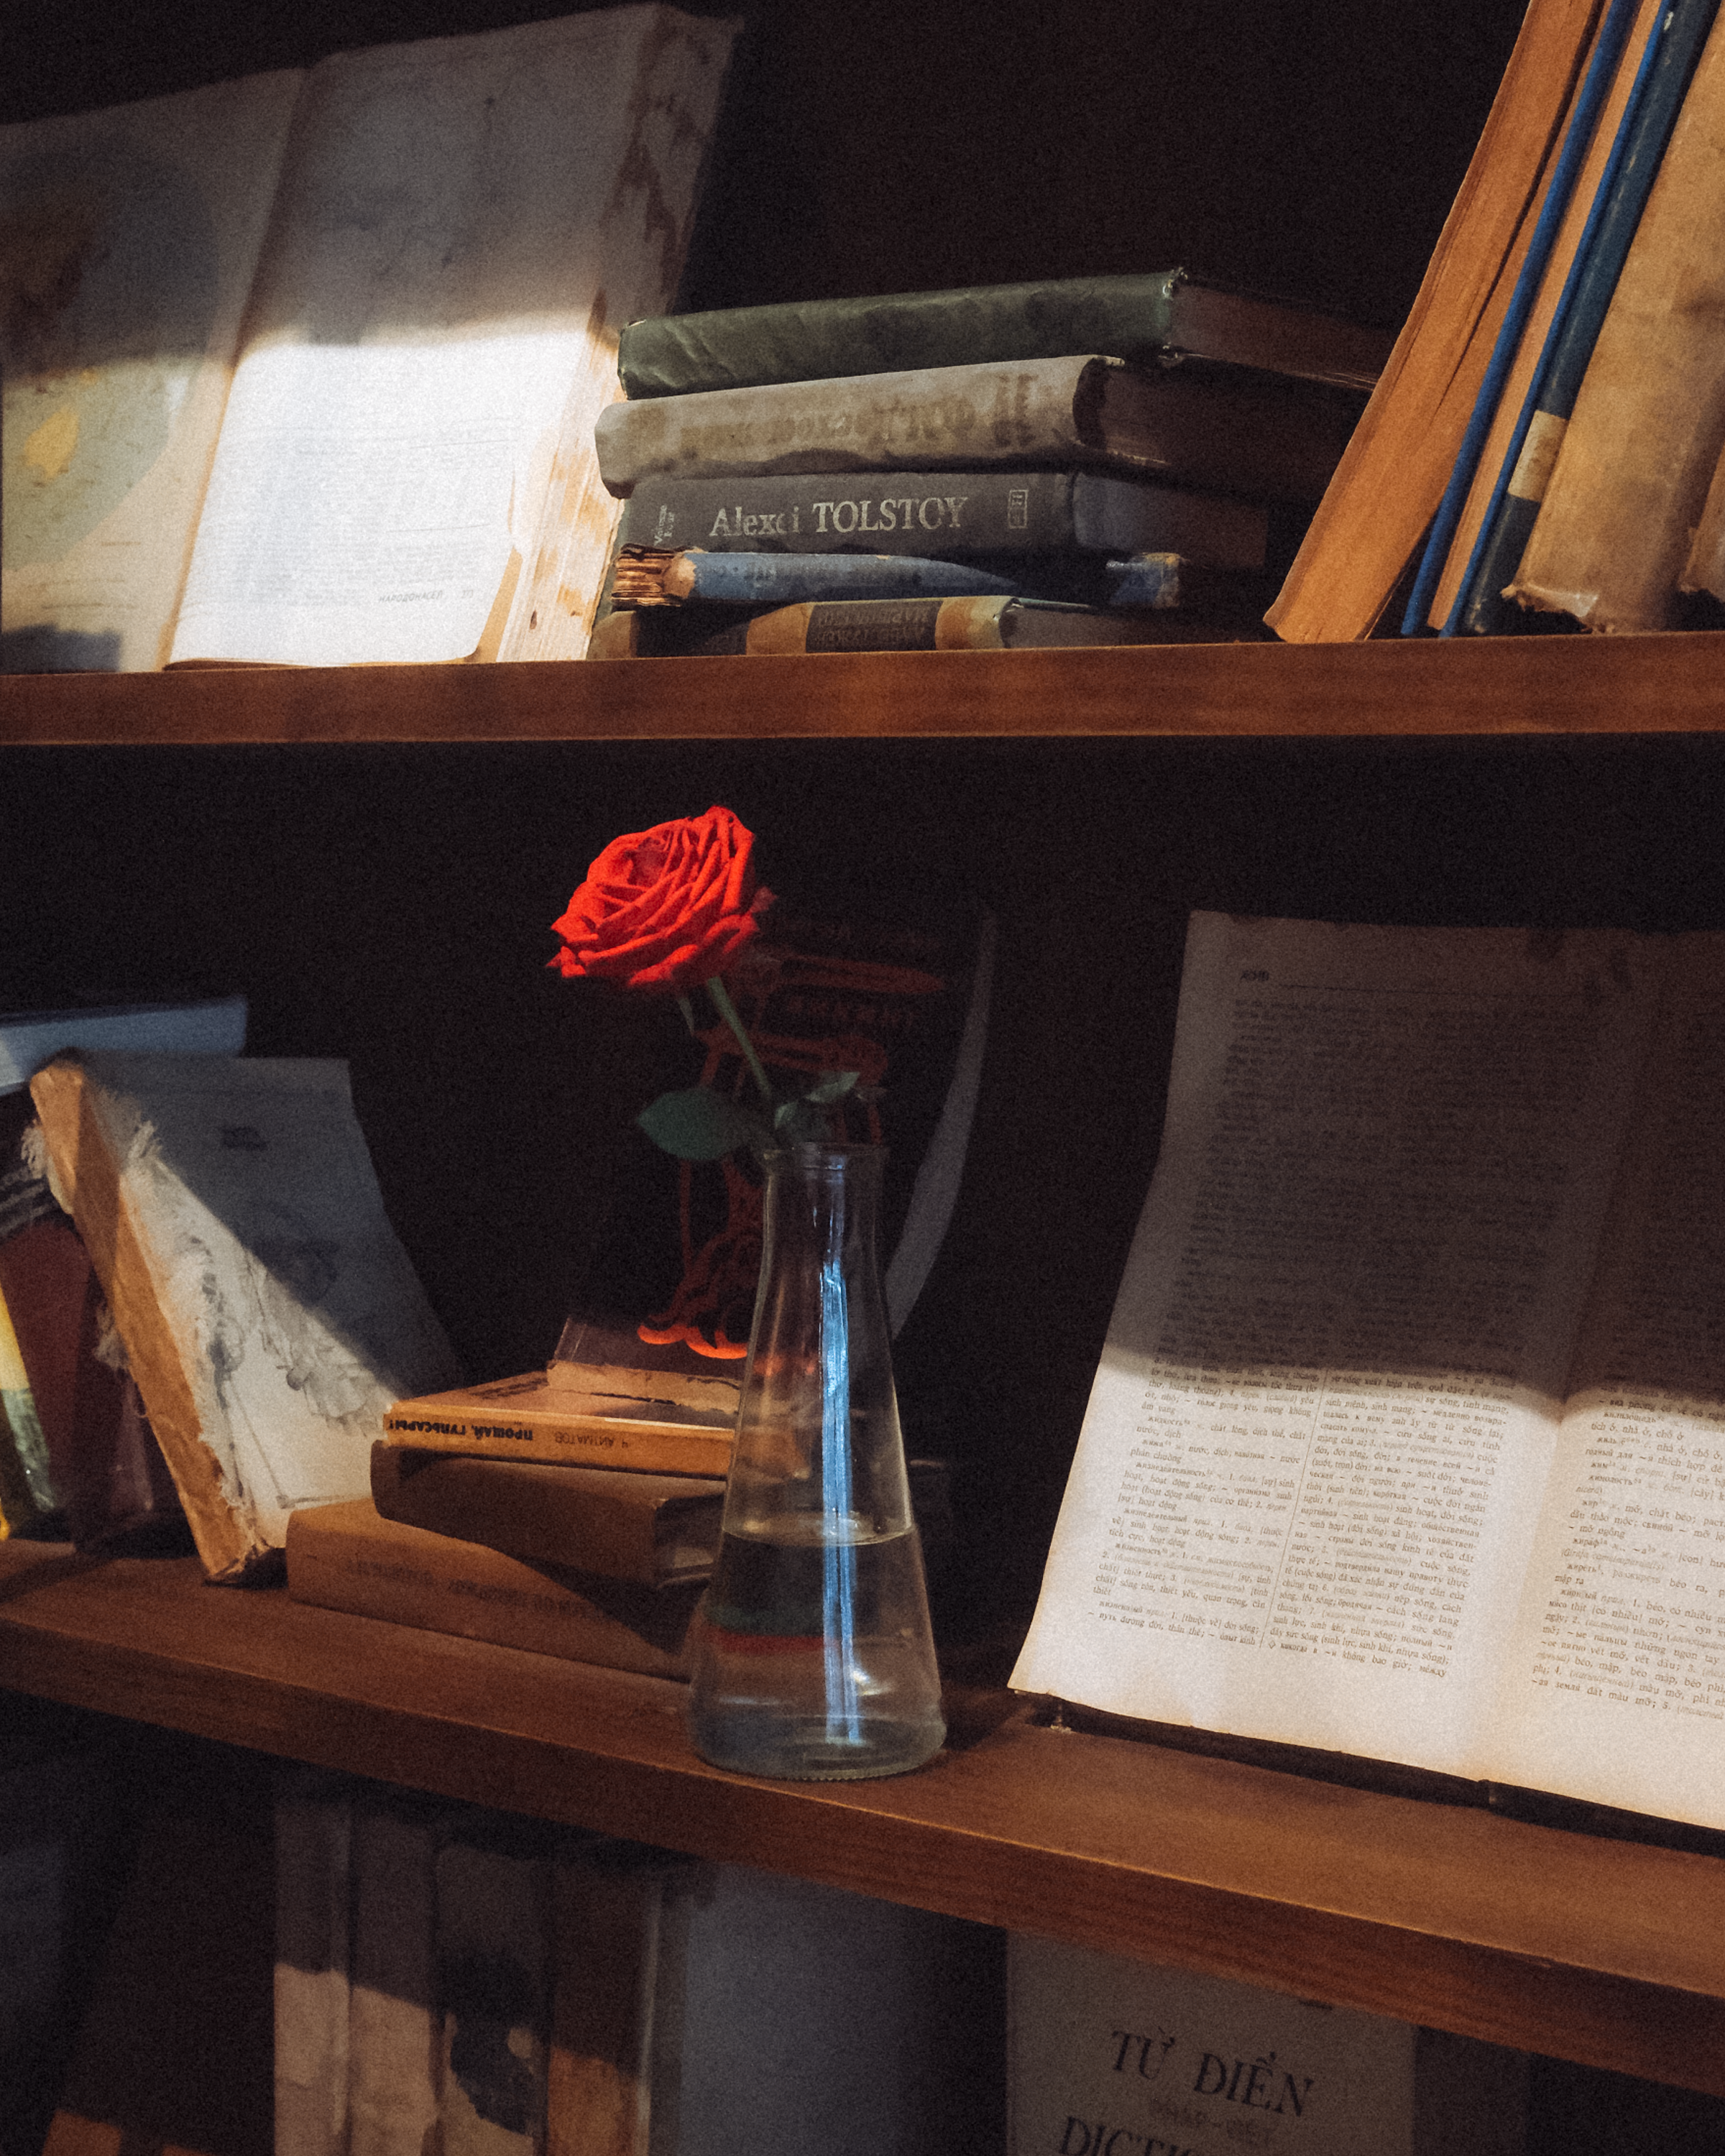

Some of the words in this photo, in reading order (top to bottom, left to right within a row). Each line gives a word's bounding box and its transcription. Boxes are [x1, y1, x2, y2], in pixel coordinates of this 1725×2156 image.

[812, 496, 969, 534] TOLSTOY
[389, 1419, 466, 1437] ГУЛЬСАРЫ!
[471, 1425, 533, 1441] ПРОЩАЙ,
[1111, 2027, 1175, 2081] TỪ
[1192, 2050, 1315, 2117] ĐIỂN
